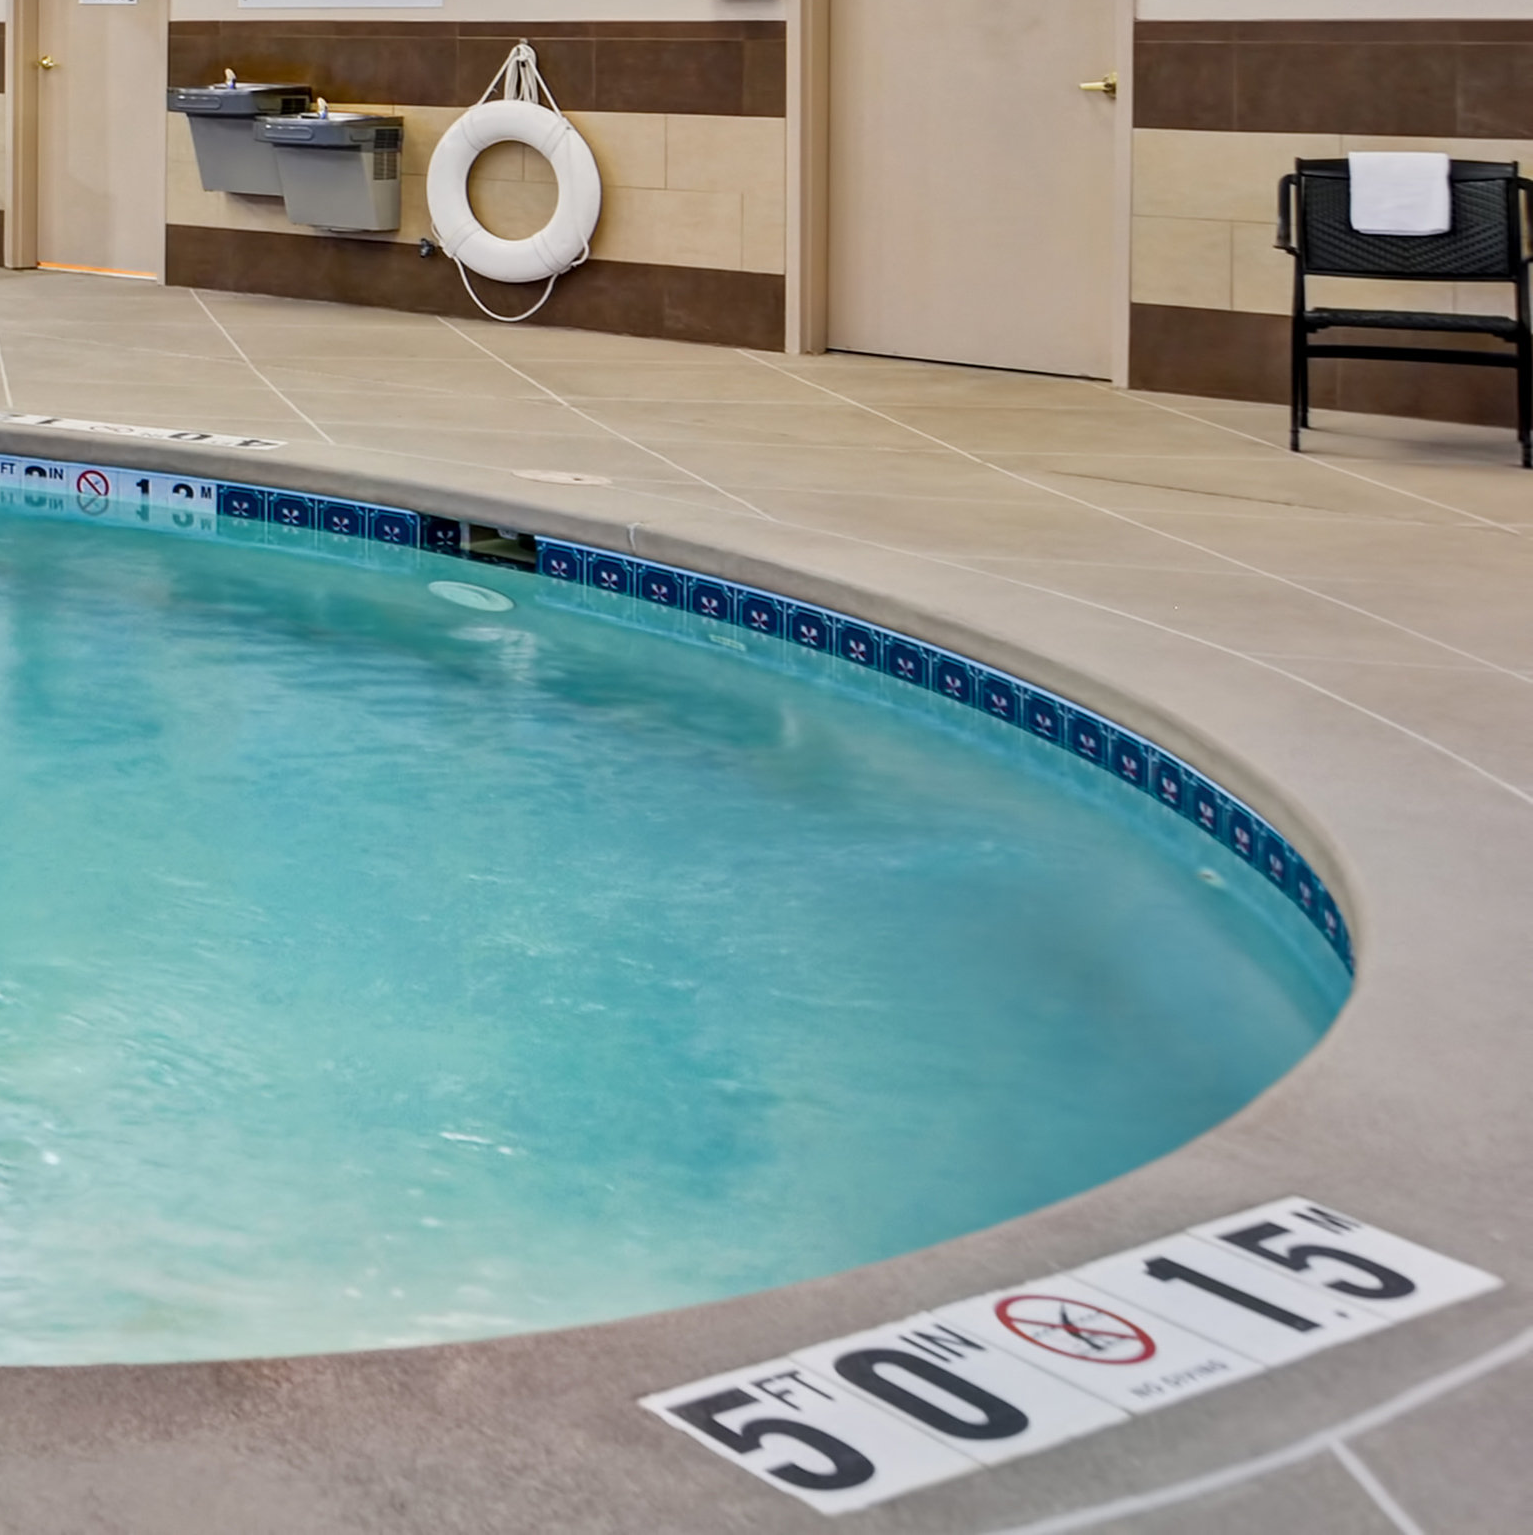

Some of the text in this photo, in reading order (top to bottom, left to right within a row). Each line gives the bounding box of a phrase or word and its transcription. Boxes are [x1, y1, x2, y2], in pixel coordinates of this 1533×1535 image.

[0, 464, 15, 475] FT
[49, 468, 64, 480] IN
[200, 486, 212, 500] M
[1290, 1206, 1362, 1236] M
[899, 1322, 988, 1363] IN
[748, 1369, 835, 1411] FT
[833, 1348, 1029, 1440] 0
[1129, 1358, 1230, 1398] NO DIVING
[667, 1388, 875, 1491] 5
